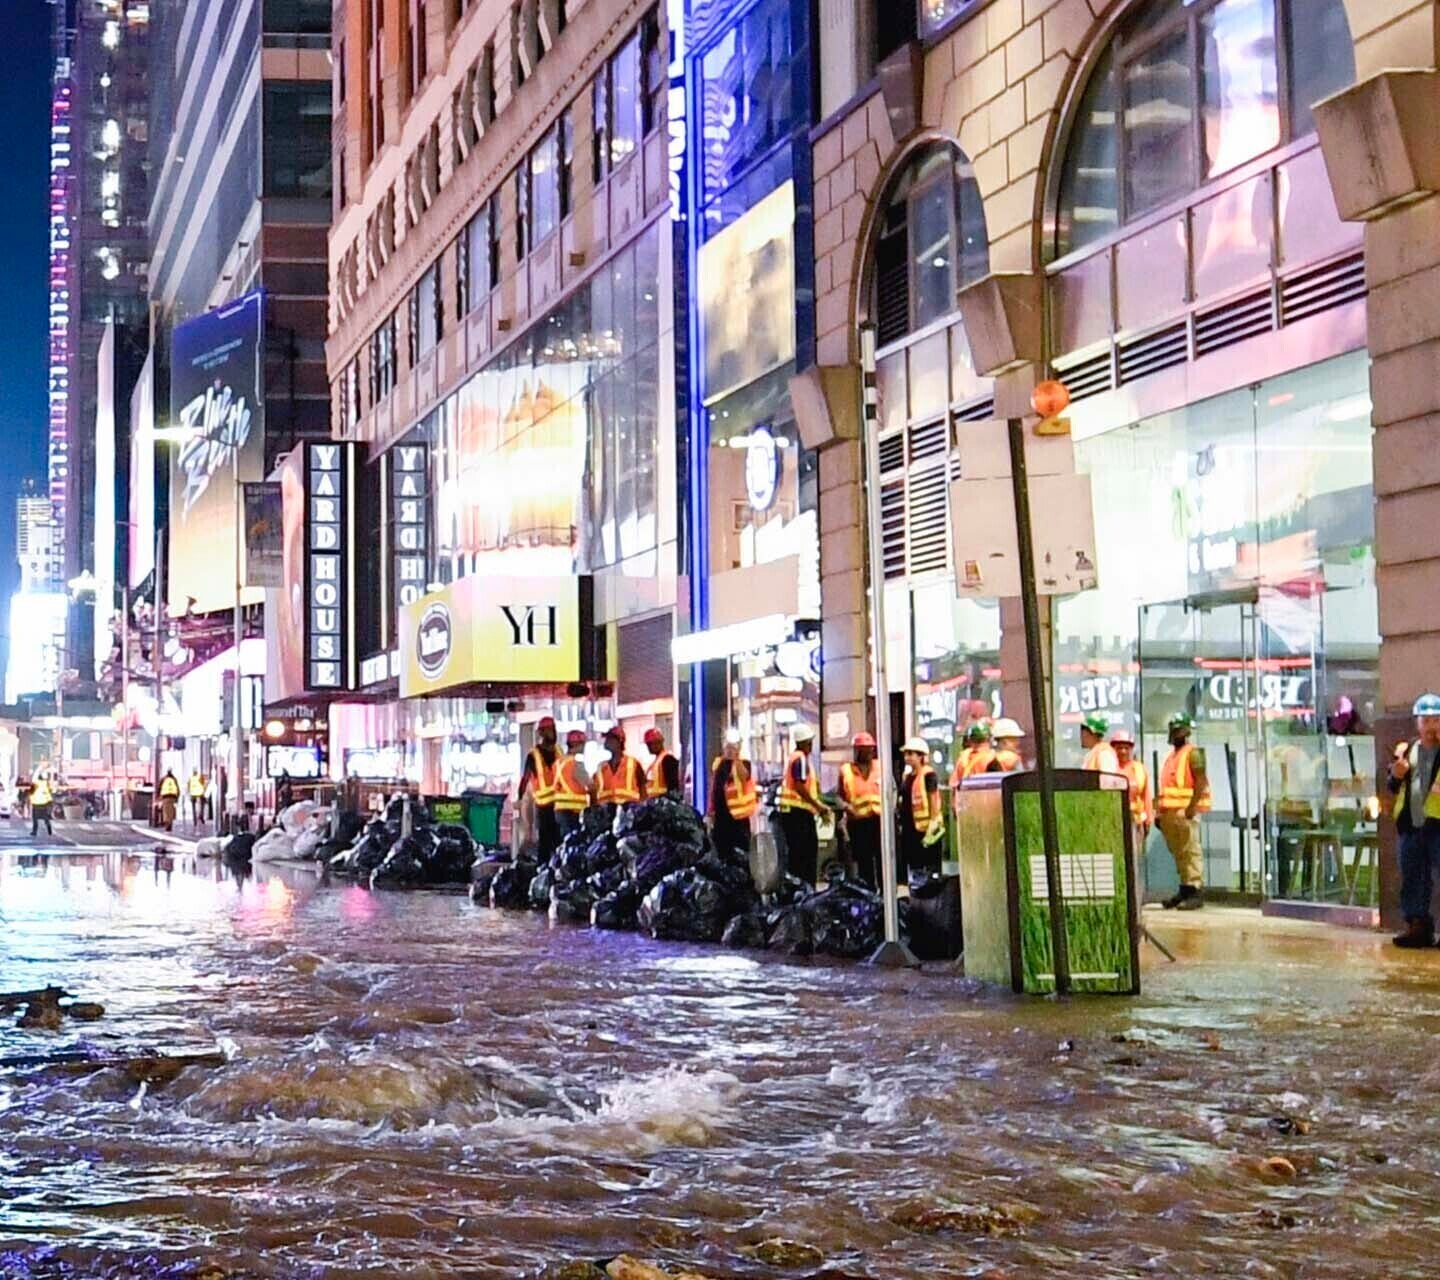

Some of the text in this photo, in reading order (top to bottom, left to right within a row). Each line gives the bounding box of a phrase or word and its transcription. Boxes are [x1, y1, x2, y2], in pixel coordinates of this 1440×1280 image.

[315, 446, 337, 685] YARD HOUSE
[499, 605, 557, 645] YH
